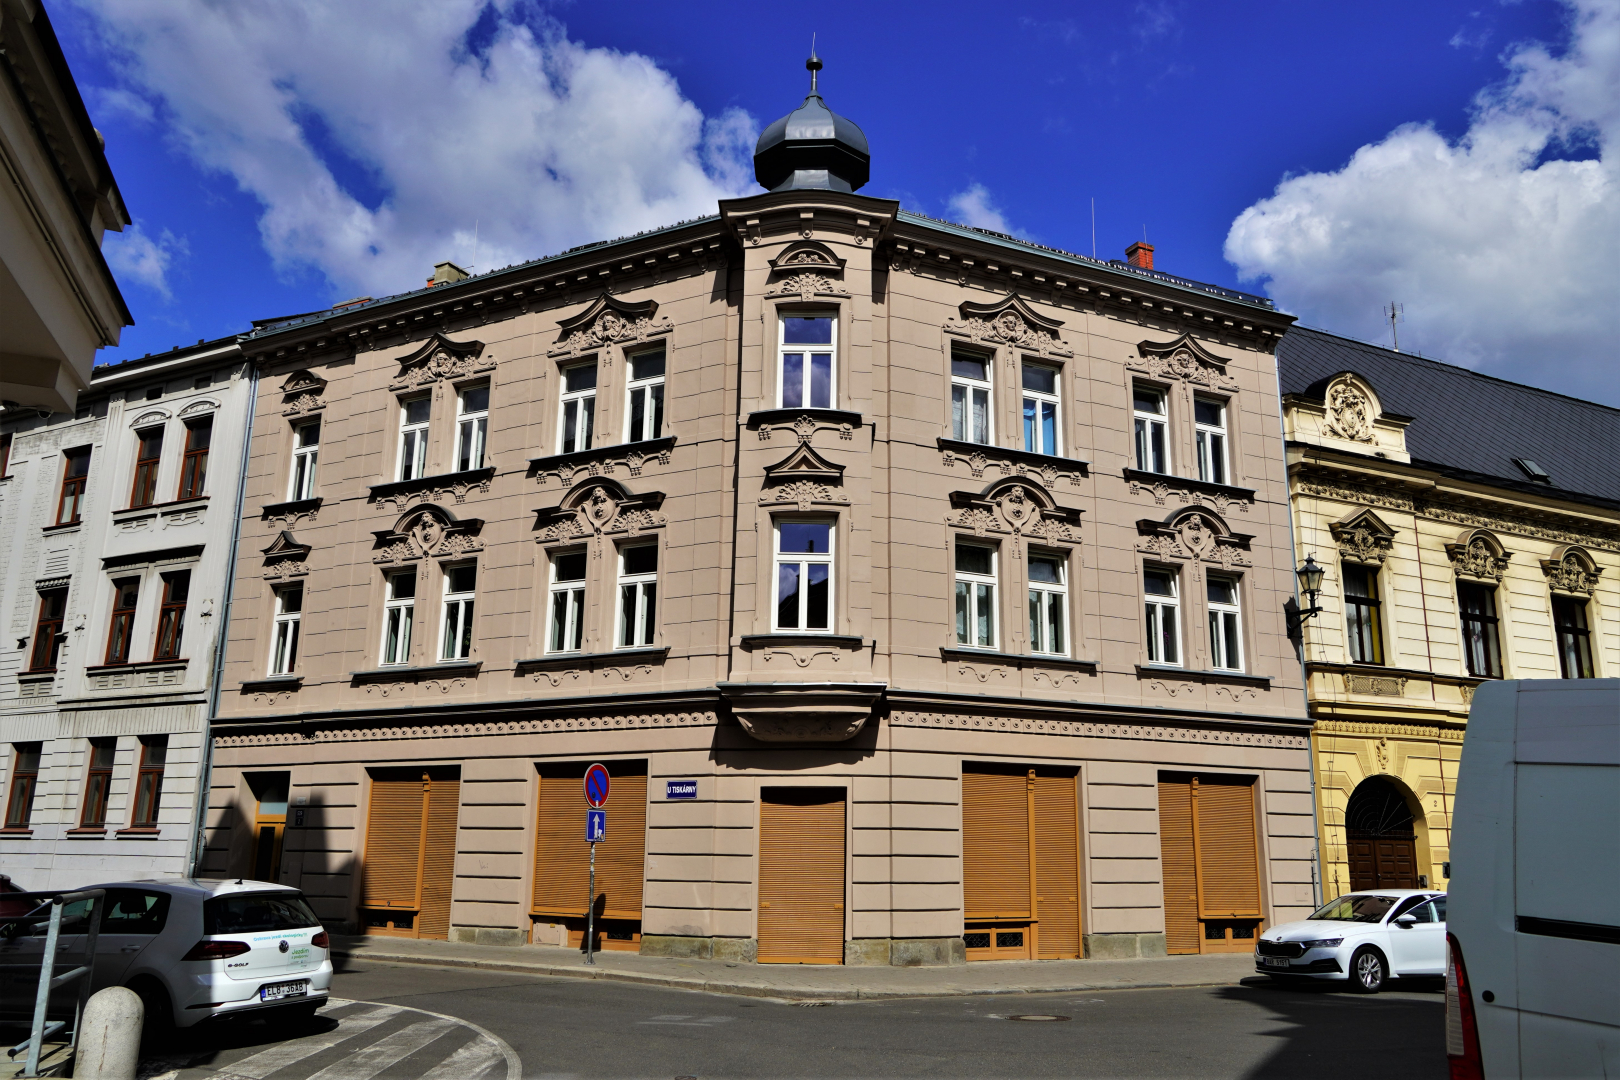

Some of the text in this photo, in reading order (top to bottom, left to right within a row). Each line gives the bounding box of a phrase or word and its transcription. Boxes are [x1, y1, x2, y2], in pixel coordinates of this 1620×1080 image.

[672, 784, 696, 793] TISKÁRNY
[267, 982, 303, 996] EL8 36AB
